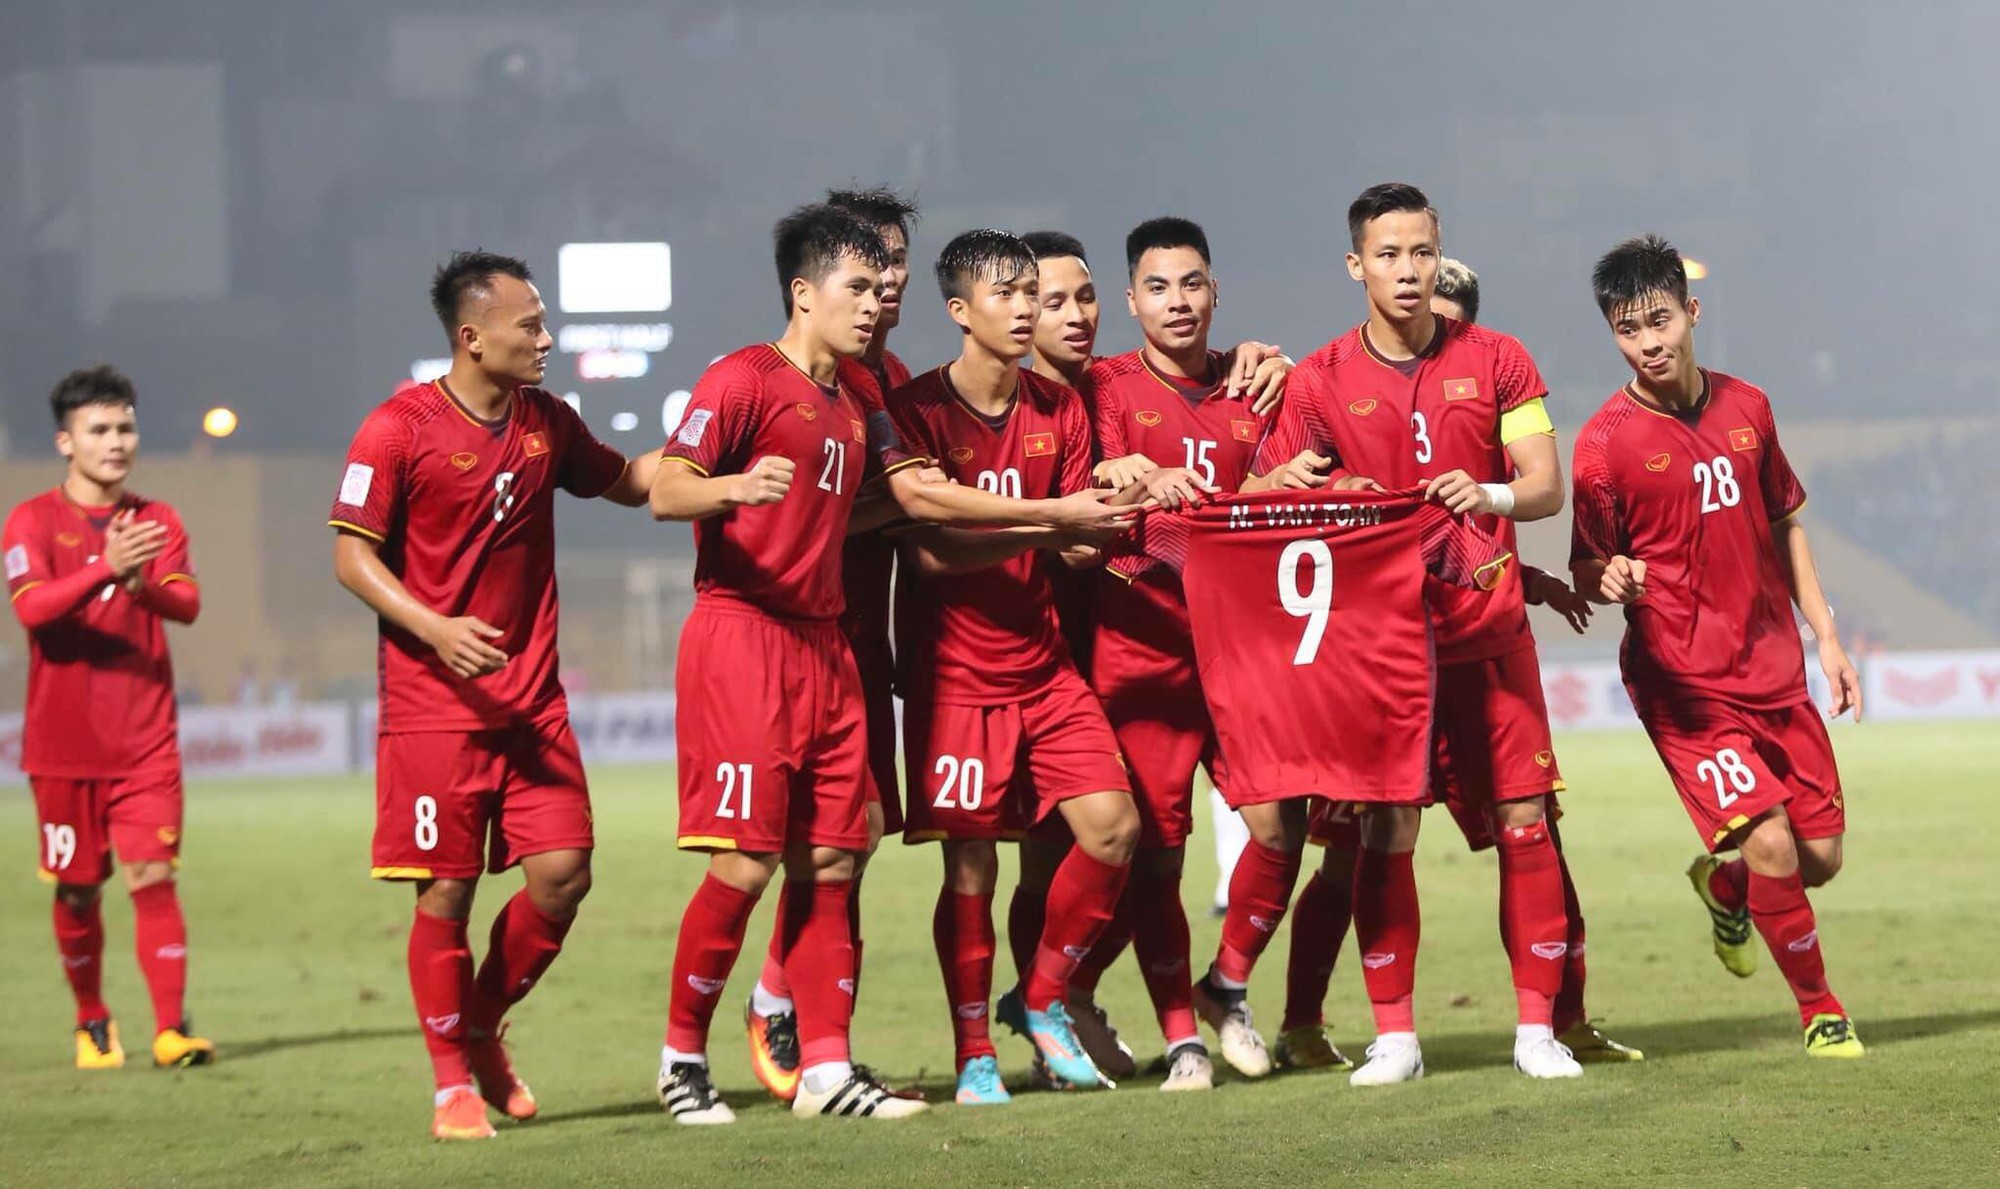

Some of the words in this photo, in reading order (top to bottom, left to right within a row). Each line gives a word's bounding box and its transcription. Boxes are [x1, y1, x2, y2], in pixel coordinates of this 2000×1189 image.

[1182, 437, 1218, 488] 15
[1410, 410, 1433, 464] 3
[817, 437, 845, 496] 21
[1692, 455, 1741, 515] 28
[1277, 539, 1333, 666] 9
[715, 761, 754, 821] 21
[932, 754, 985, 812] 20
[1696, 747, 1757, 810] 28
[43, 822, 77, 870] 19
[414, 795, 439, 852] 8
